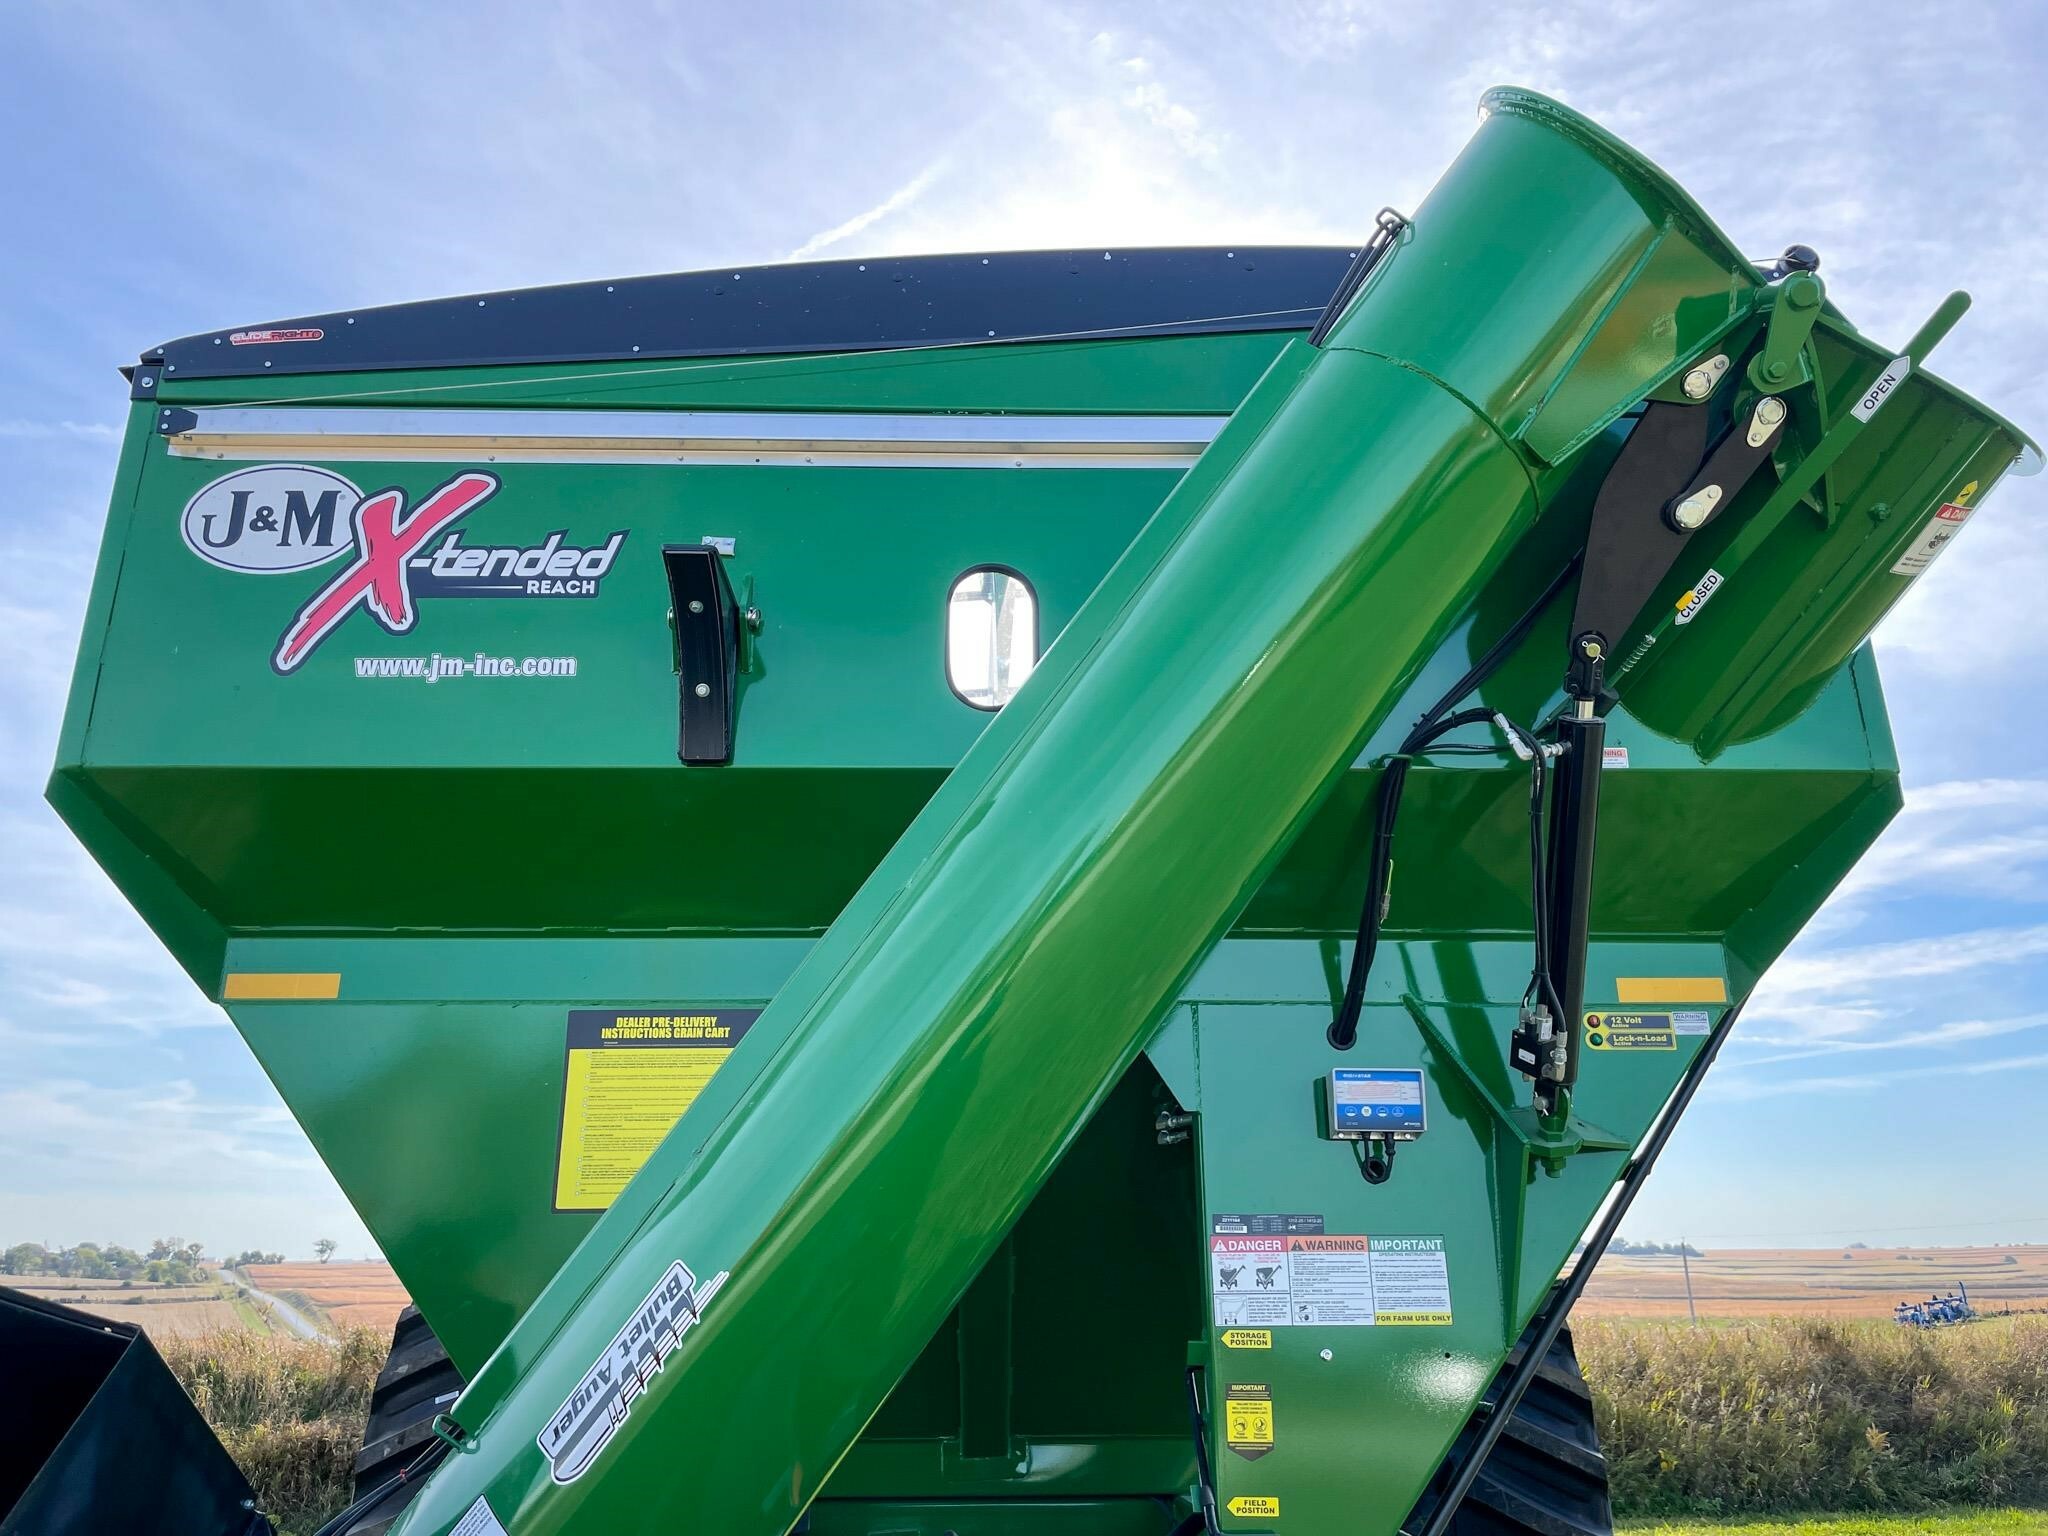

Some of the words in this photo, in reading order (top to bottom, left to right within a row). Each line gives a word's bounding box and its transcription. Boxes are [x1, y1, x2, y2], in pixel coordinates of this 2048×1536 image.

[1864, 374, 1896, 410] OPEN
[202, 490, 341, 548] J&M
[527, 580, 595, 594] REACH
[1681, 575, 1718, 618] CLOSED
[355, 653, 577, 683] www.jm-inc.com
[616, 1016, 651, 1028] DEALER
[652, 1016, 718, 1027] PRE-DELIVERY
[1611, 1016, 1623, 1024] 12
[1624, 1016, 1642, 1024] Volt
[601, 1027, 673, 1039] INSTRUCTIONS
[674, 1027, 704, 1039] GRAIN
[705, 1027, 731, 1038] CART
[1613, 1034, 1667, 1042] Lock-n-Load
[1228, 1240, 1282, 1252] DANGER
[1305, 1240, 1365, 1251] WARNING
[1371, 1239, 1443, 1251] IMPORTANT
[618, 1271, 683, 1360] Bullet
[552, 1358, 611, 1447] Auger
[1243, 1499, 1267, 1507] FIELD
[1236, 1506, 1275, 1514] POSITION
